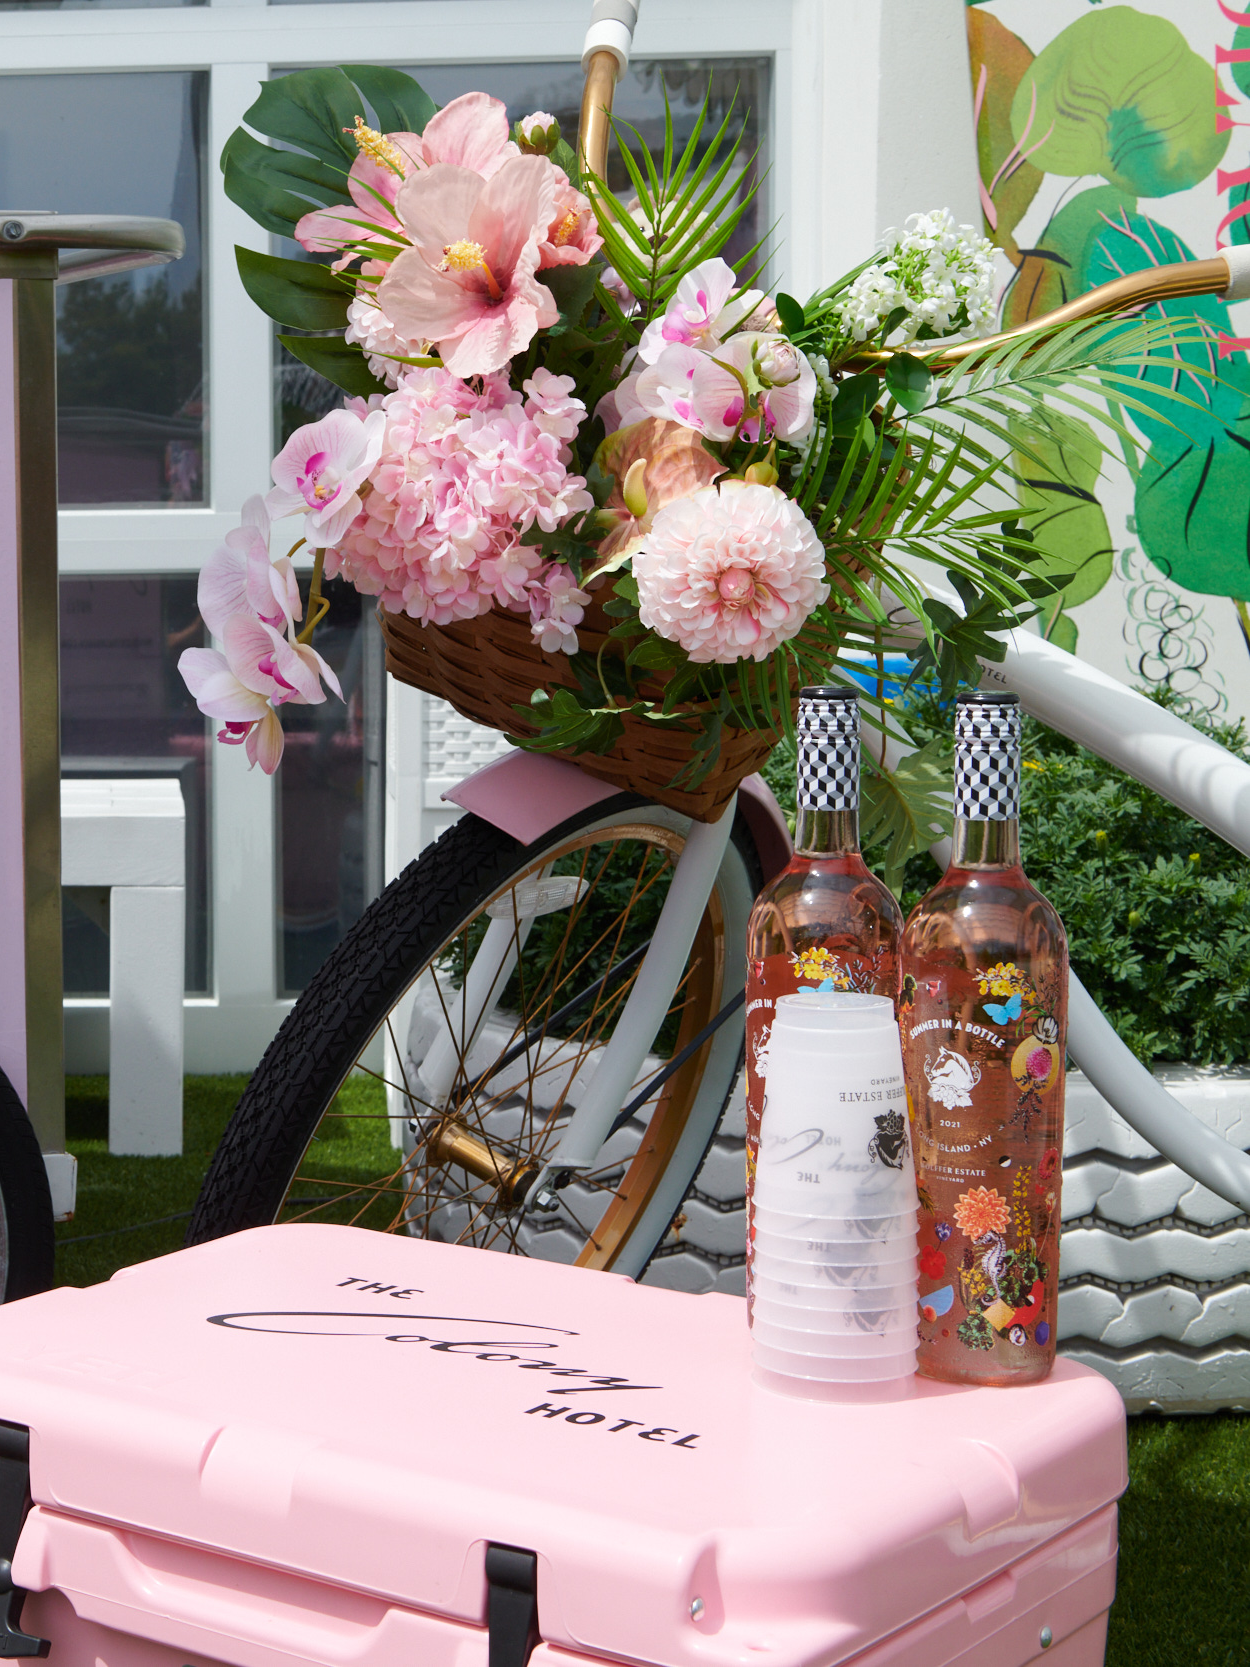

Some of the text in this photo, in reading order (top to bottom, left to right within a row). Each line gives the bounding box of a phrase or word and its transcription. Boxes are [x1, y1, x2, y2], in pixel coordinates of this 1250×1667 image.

[980, 664, 1007, 684] OTEL
[910, 1019, 1006, 1048] SUMMER IN A BOTTLE
[839, 1092, 883, 1102] ESTATE
[940, 1120, 960, 1128] 2021
[937, 1143, 971, 1153] ISLAND
[978, 1135, 992, 1147] NY
[796, 1172, 821, 1184] THE
[955, 1167, 986, 1177] ESTATE
[336, 1277, 424, 1300] THE
[206, 1311, 664, 1395] Colony
[524, 1402, 700, 1449] HOTEL
